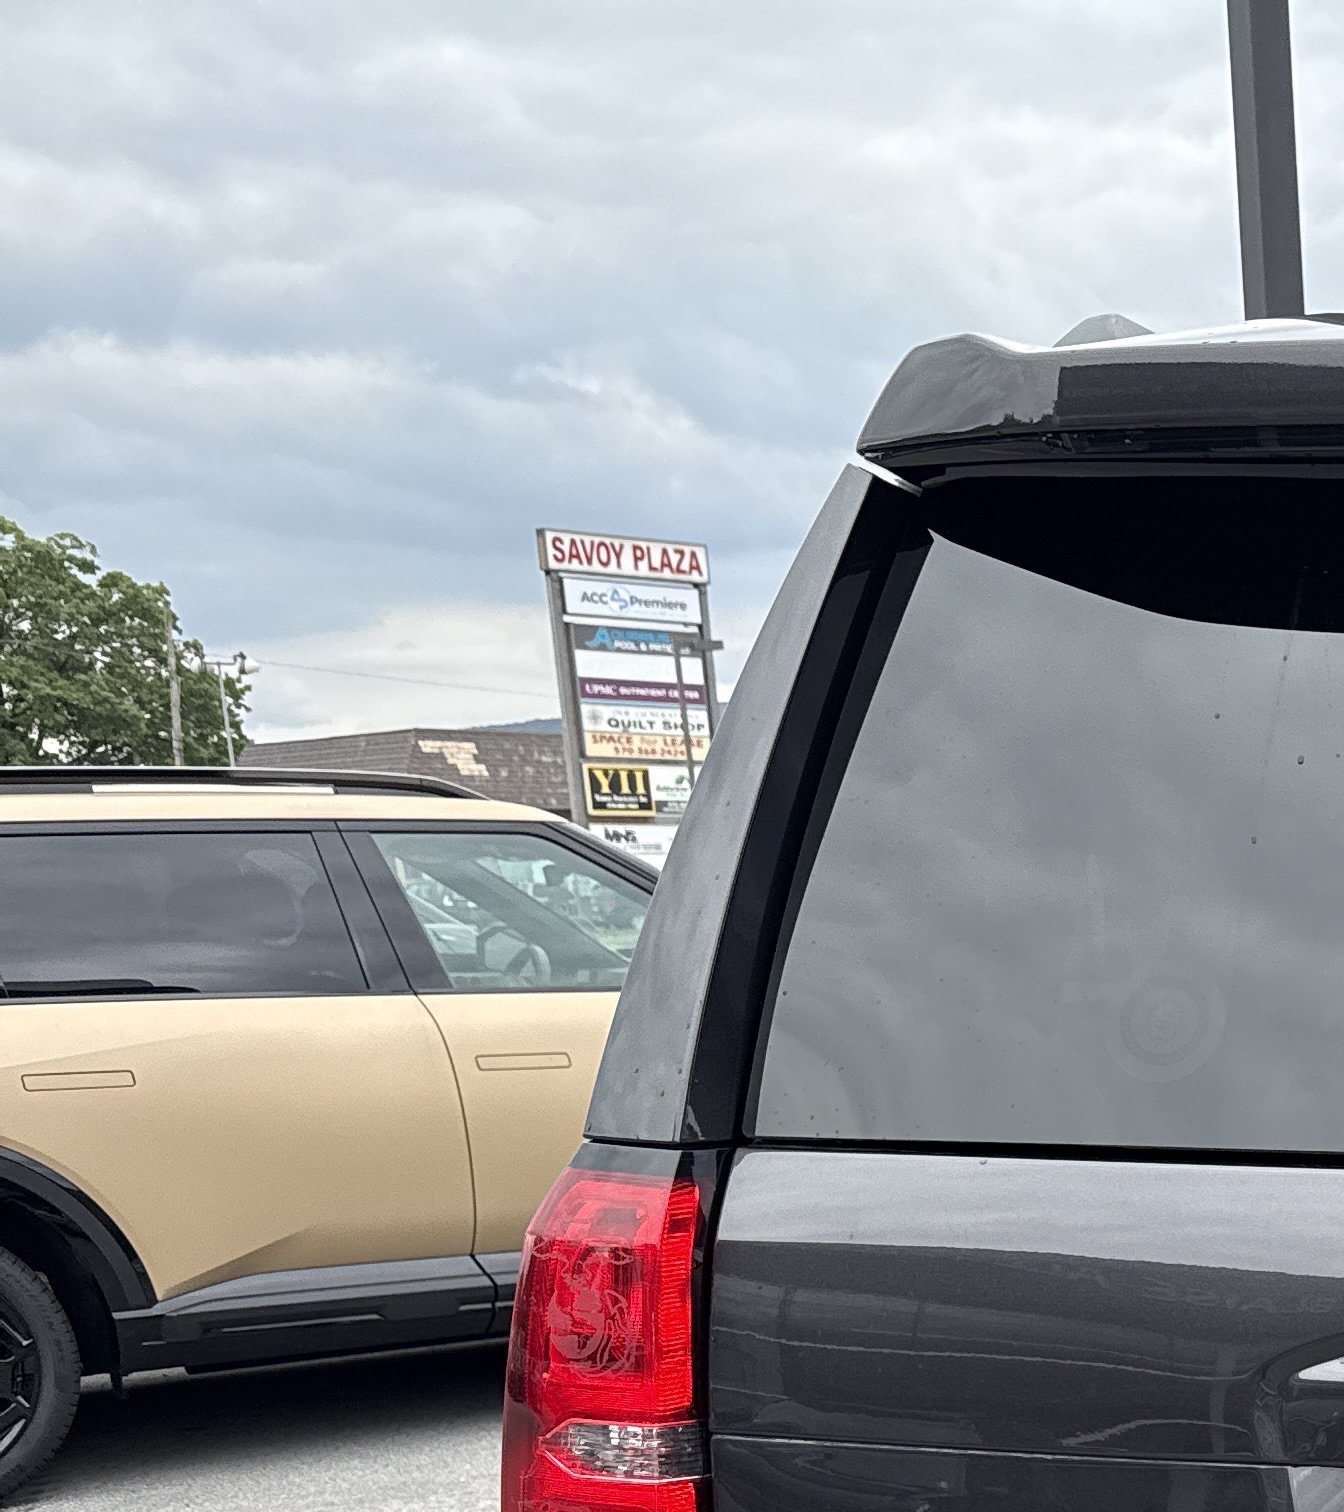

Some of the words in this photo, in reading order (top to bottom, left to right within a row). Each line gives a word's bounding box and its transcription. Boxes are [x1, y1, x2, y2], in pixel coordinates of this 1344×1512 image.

[552, 536, 624, 569] SAVOY
[632, 544, 703, 576] PLAZA
[581, 592, 609, 605] ACC
[630, 596, 687, 611] Premiere
[585, 683, 618, 696] UPMC
[607, 717, 656, 731] QUILT
[591, 734, 633, 745] SPACE
